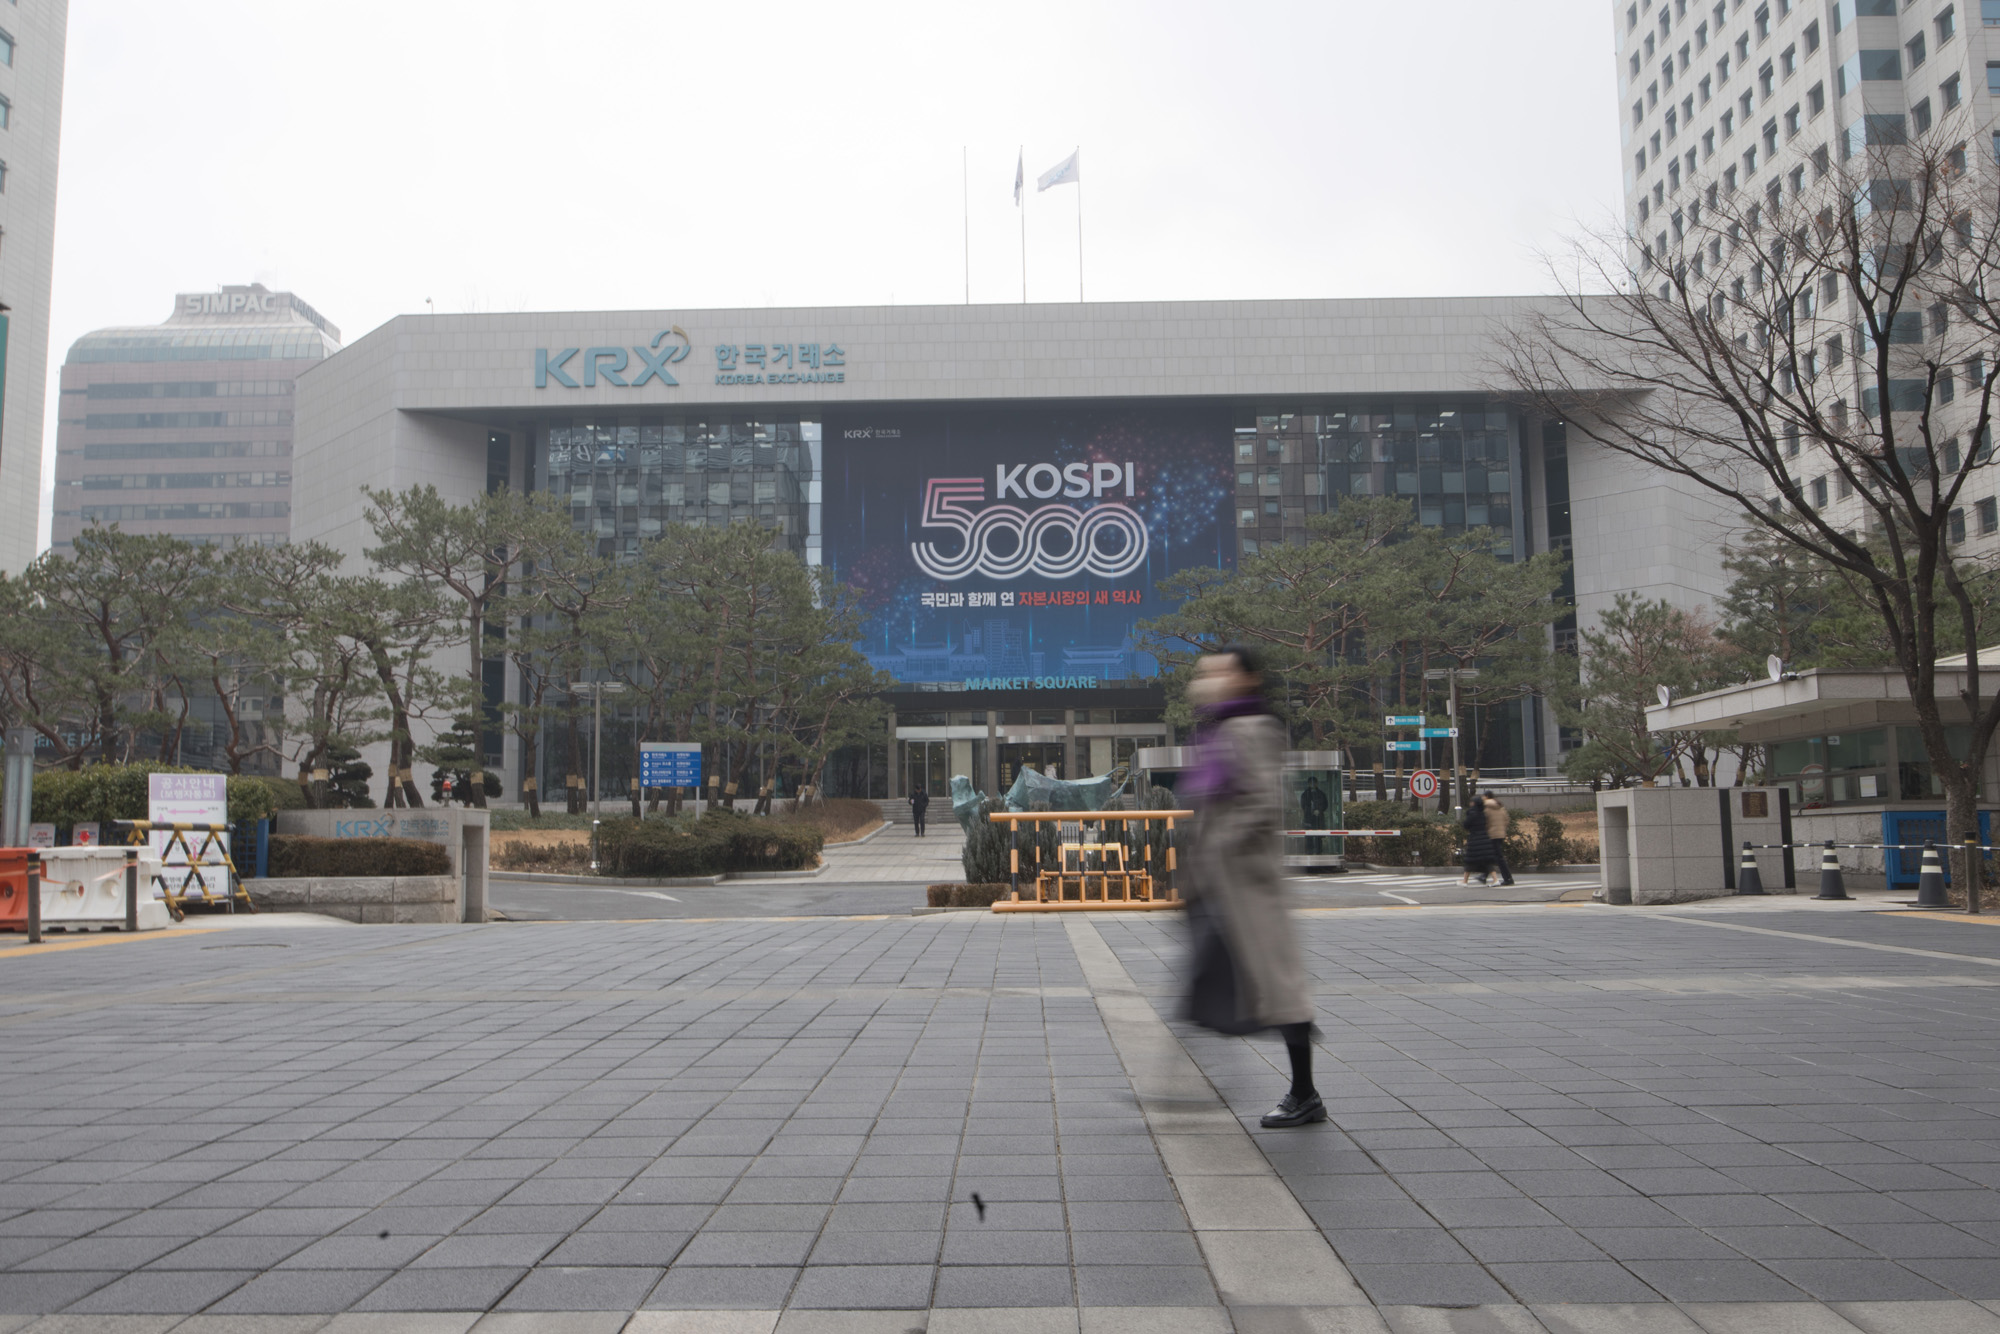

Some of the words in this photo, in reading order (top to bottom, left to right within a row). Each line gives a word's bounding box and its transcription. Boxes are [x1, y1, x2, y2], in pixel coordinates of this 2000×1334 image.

[185, 293, 277, 315] SIMPAC
[714, 343, 846, 370] 한국거래소
[534, 346, 680, 388] KRX
[714, 374, 765, 386] KOREA
[767, 372, 846, 384] EXCHANGE
[844, 430, 871, 439] KRX
[996, 462, 1135, 499] KOSPI
[911, 478, 1149, 581] 5000
[921, 592, 965, 607] 국민과
[968, 591, 997, 607] 함께
[1000, 591, 1015, 607] 연
[1018, 590, 1091, 606] 자본시장의
[1094, 589, 1109, 605] 새
[1112, 589, 1142, 605] 역사
[965, 677, 1031, 691] MARKET
[1034, 675, 1097, 690] SQUARE
[160, 777, 215, 789] 공사안내
[1415, 777, 1432, 791] 10
[335, 820, 391, 838] KRX
